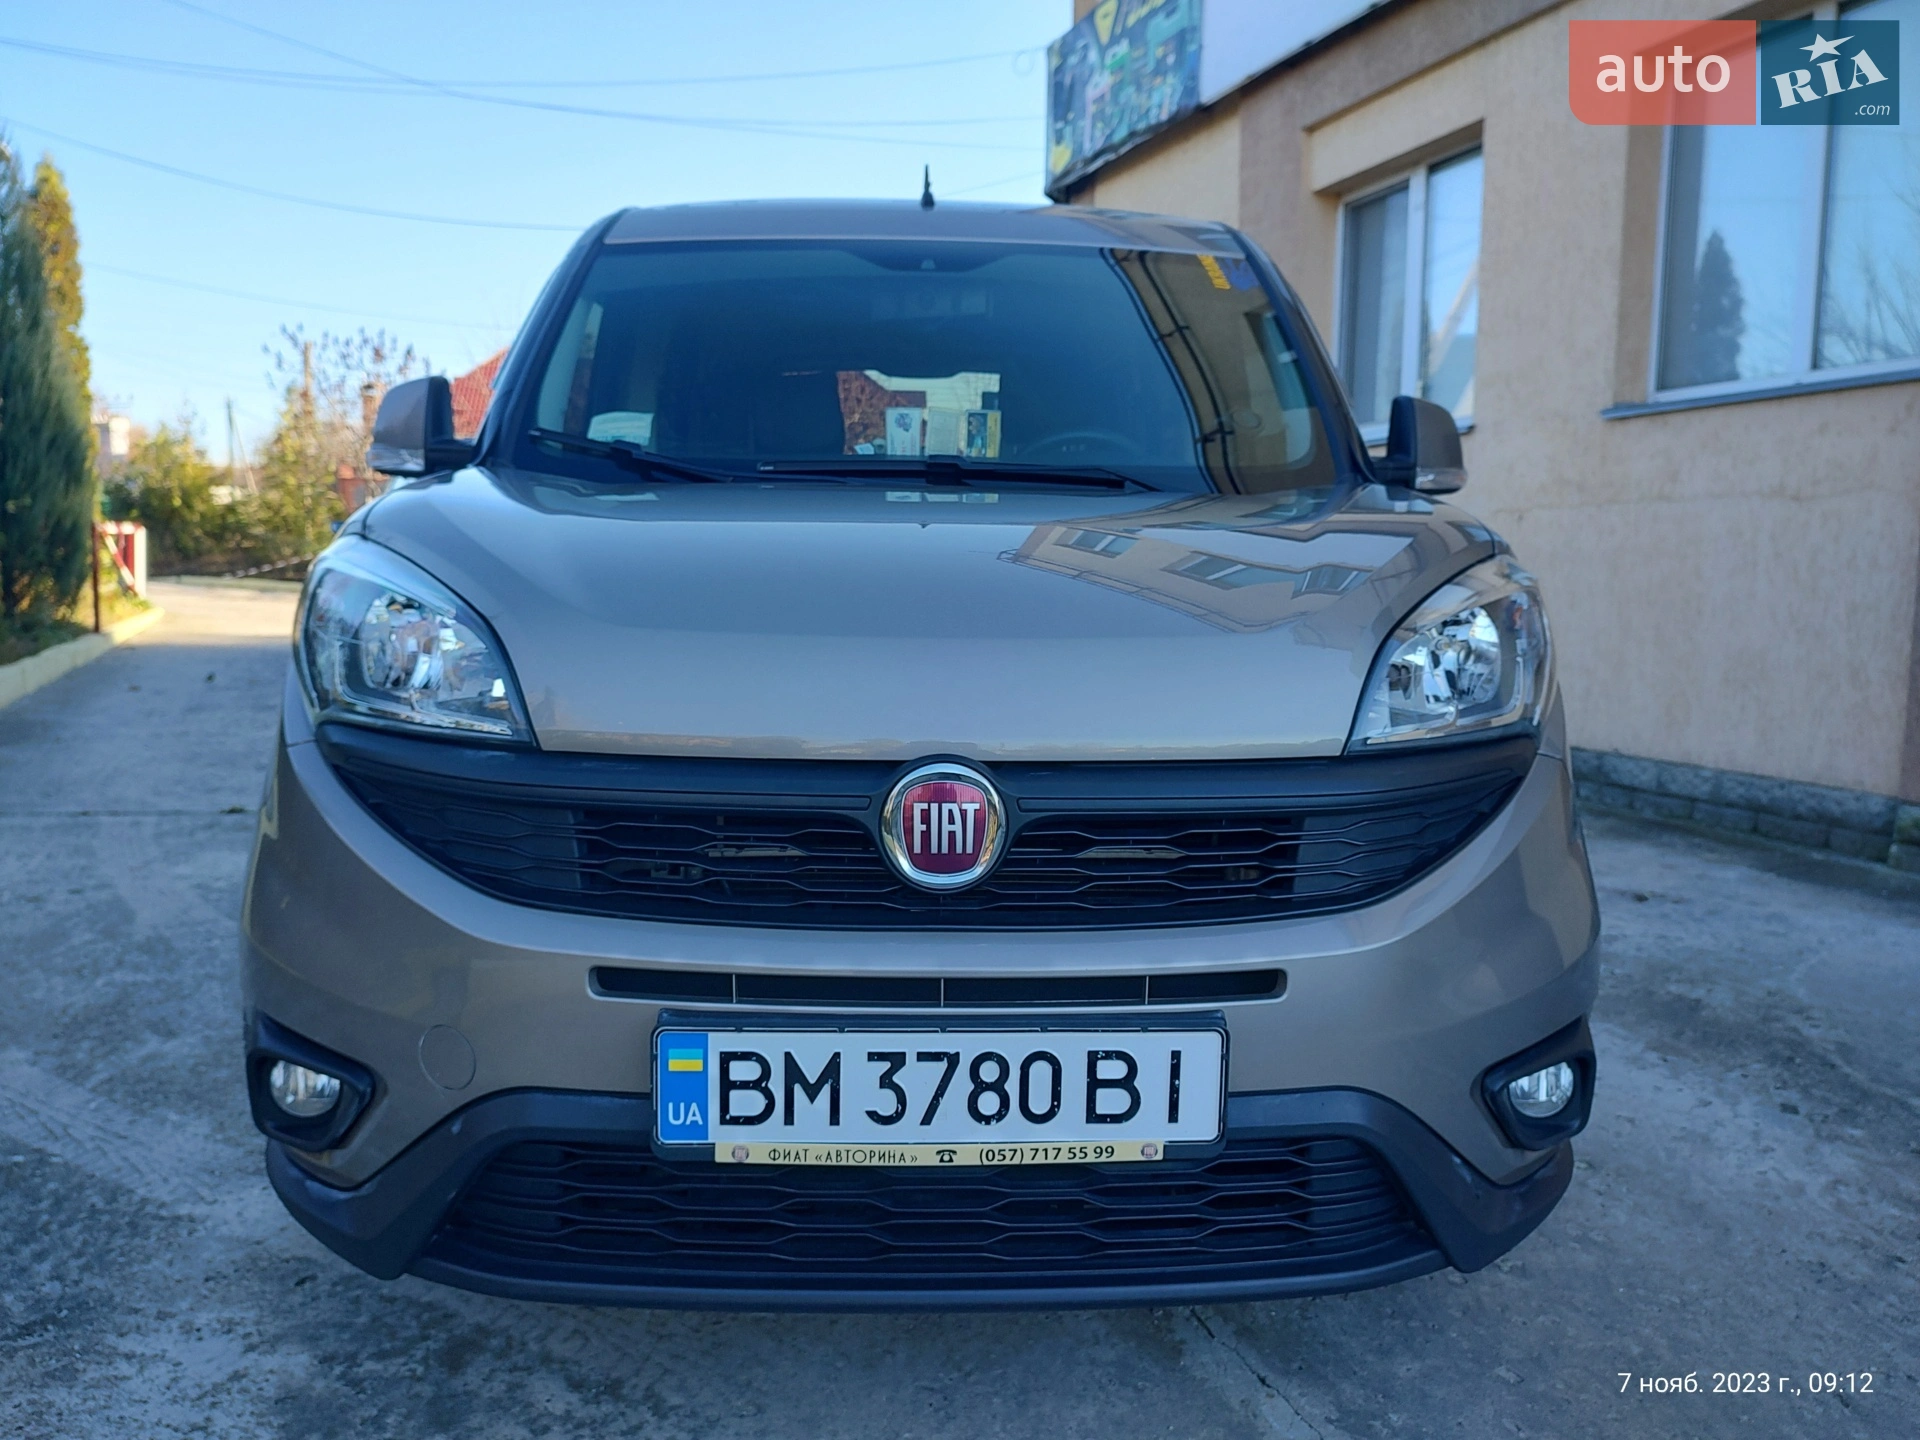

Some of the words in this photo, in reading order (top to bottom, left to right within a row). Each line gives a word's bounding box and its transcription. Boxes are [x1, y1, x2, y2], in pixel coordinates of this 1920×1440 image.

[913, 802, 980, 854] FIAT
[718, 1050, 842, 1126] BM
[864, 1050, 1062, 1126] 3780
[1085, 1050, 1181, 1125] BI
[668, 1103, 703, 1126] UA
[768, 1148, 810, 1162] ФИАТ
[979, 1148, 1025, 1164] (057)
[1029, 1147, 1062, 1161] 717
[1067, 1146, 1088, 1160] 55
[1093, 1145, 1115, 1159] 99
